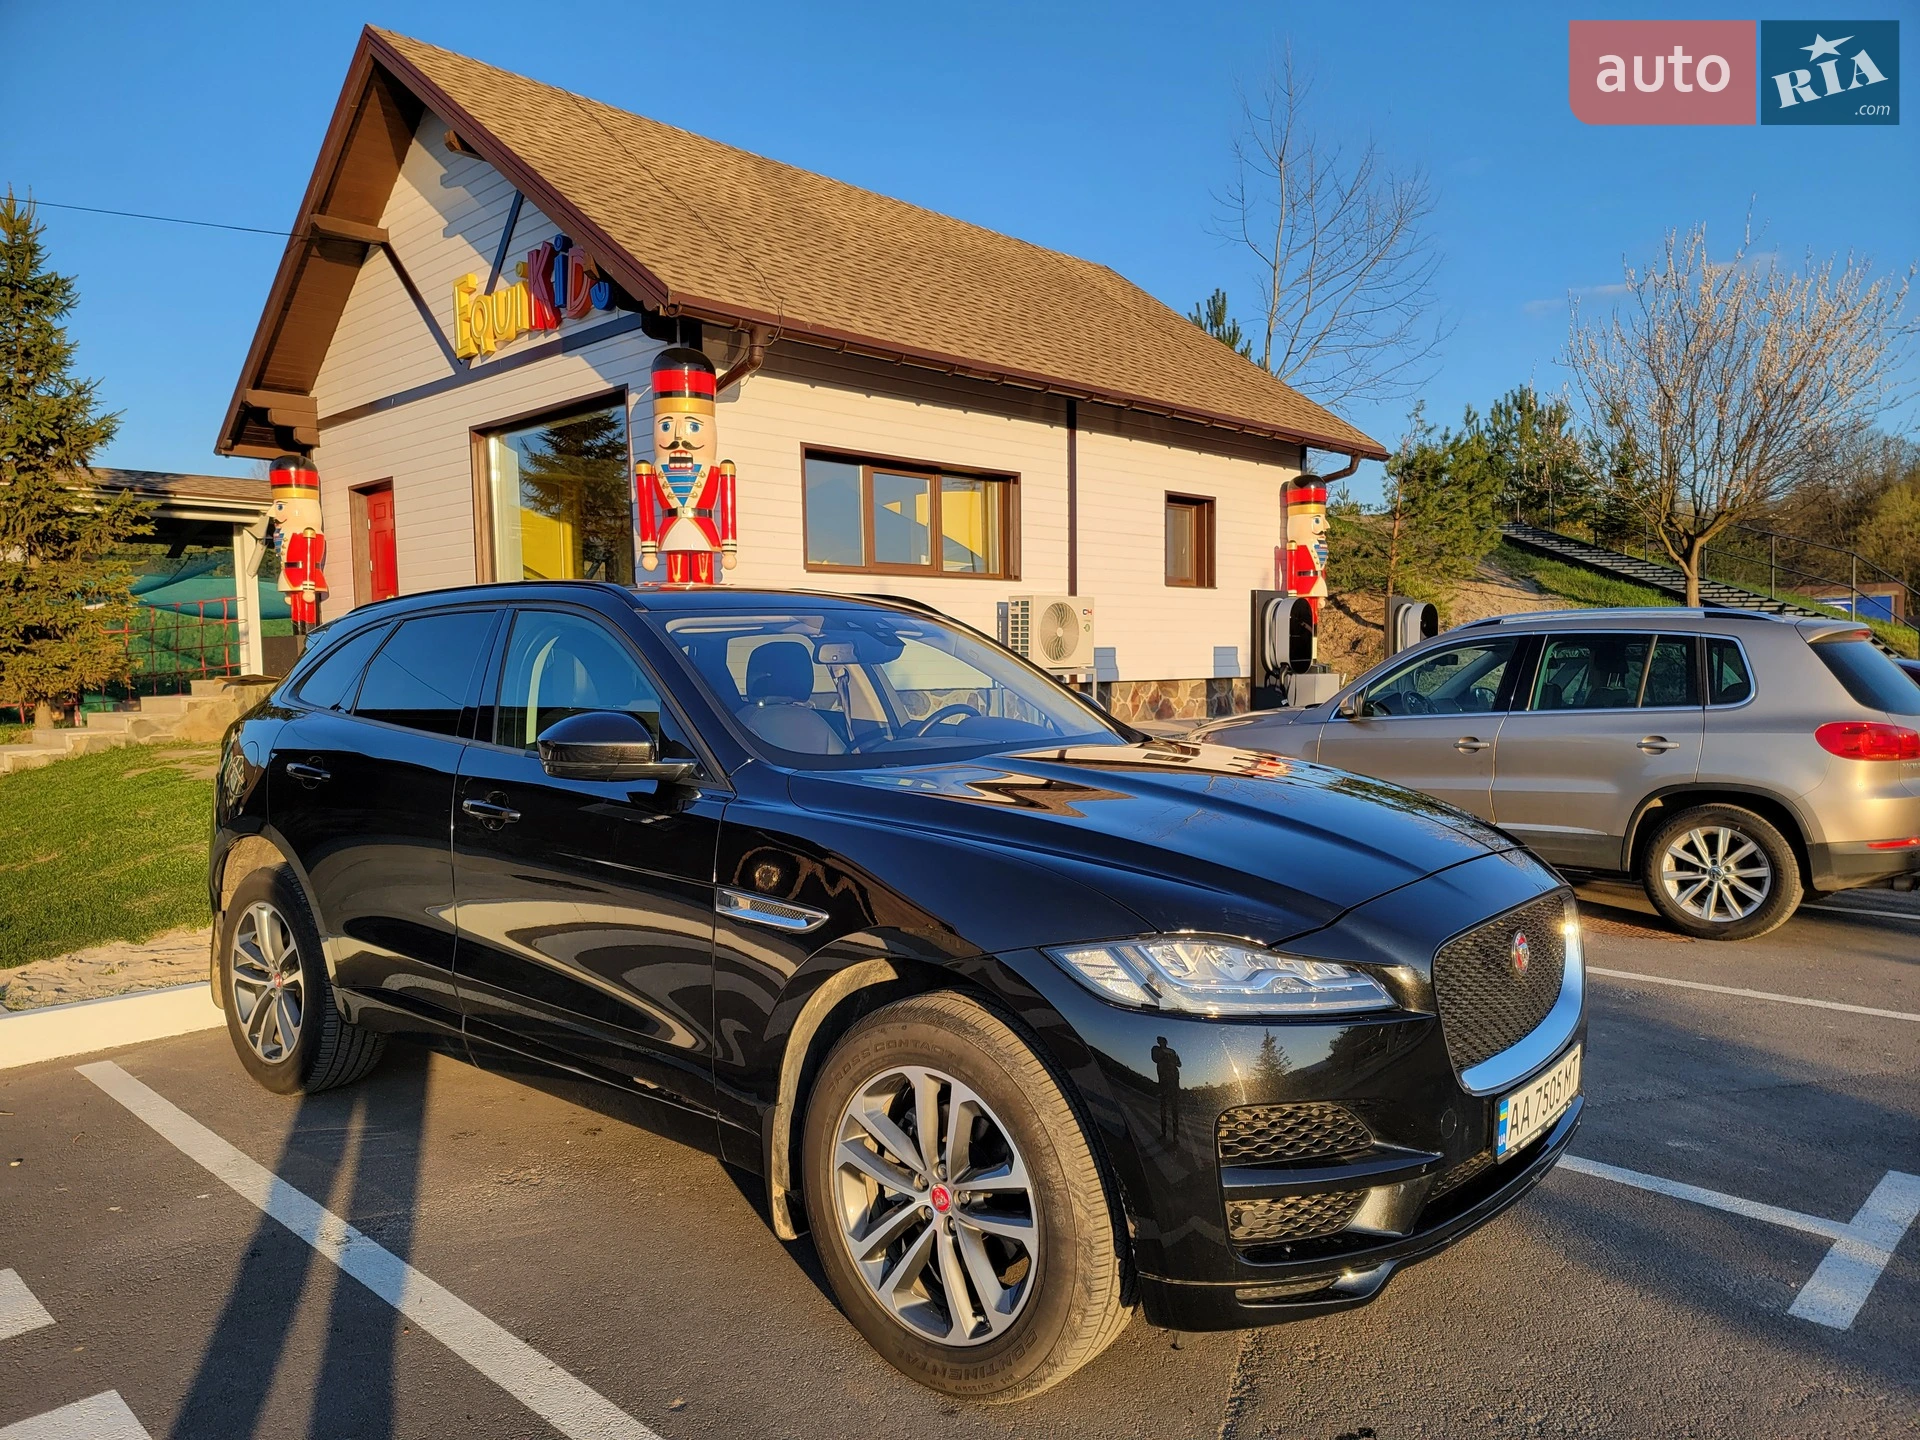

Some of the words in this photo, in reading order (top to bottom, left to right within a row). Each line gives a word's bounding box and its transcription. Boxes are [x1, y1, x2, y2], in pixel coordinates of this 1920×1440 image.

[1508, 1095, 1530, 1141] AA
[1534, 1070, 1563, 1124] 7505
[1563, 1053, 1579, 1097] MT
